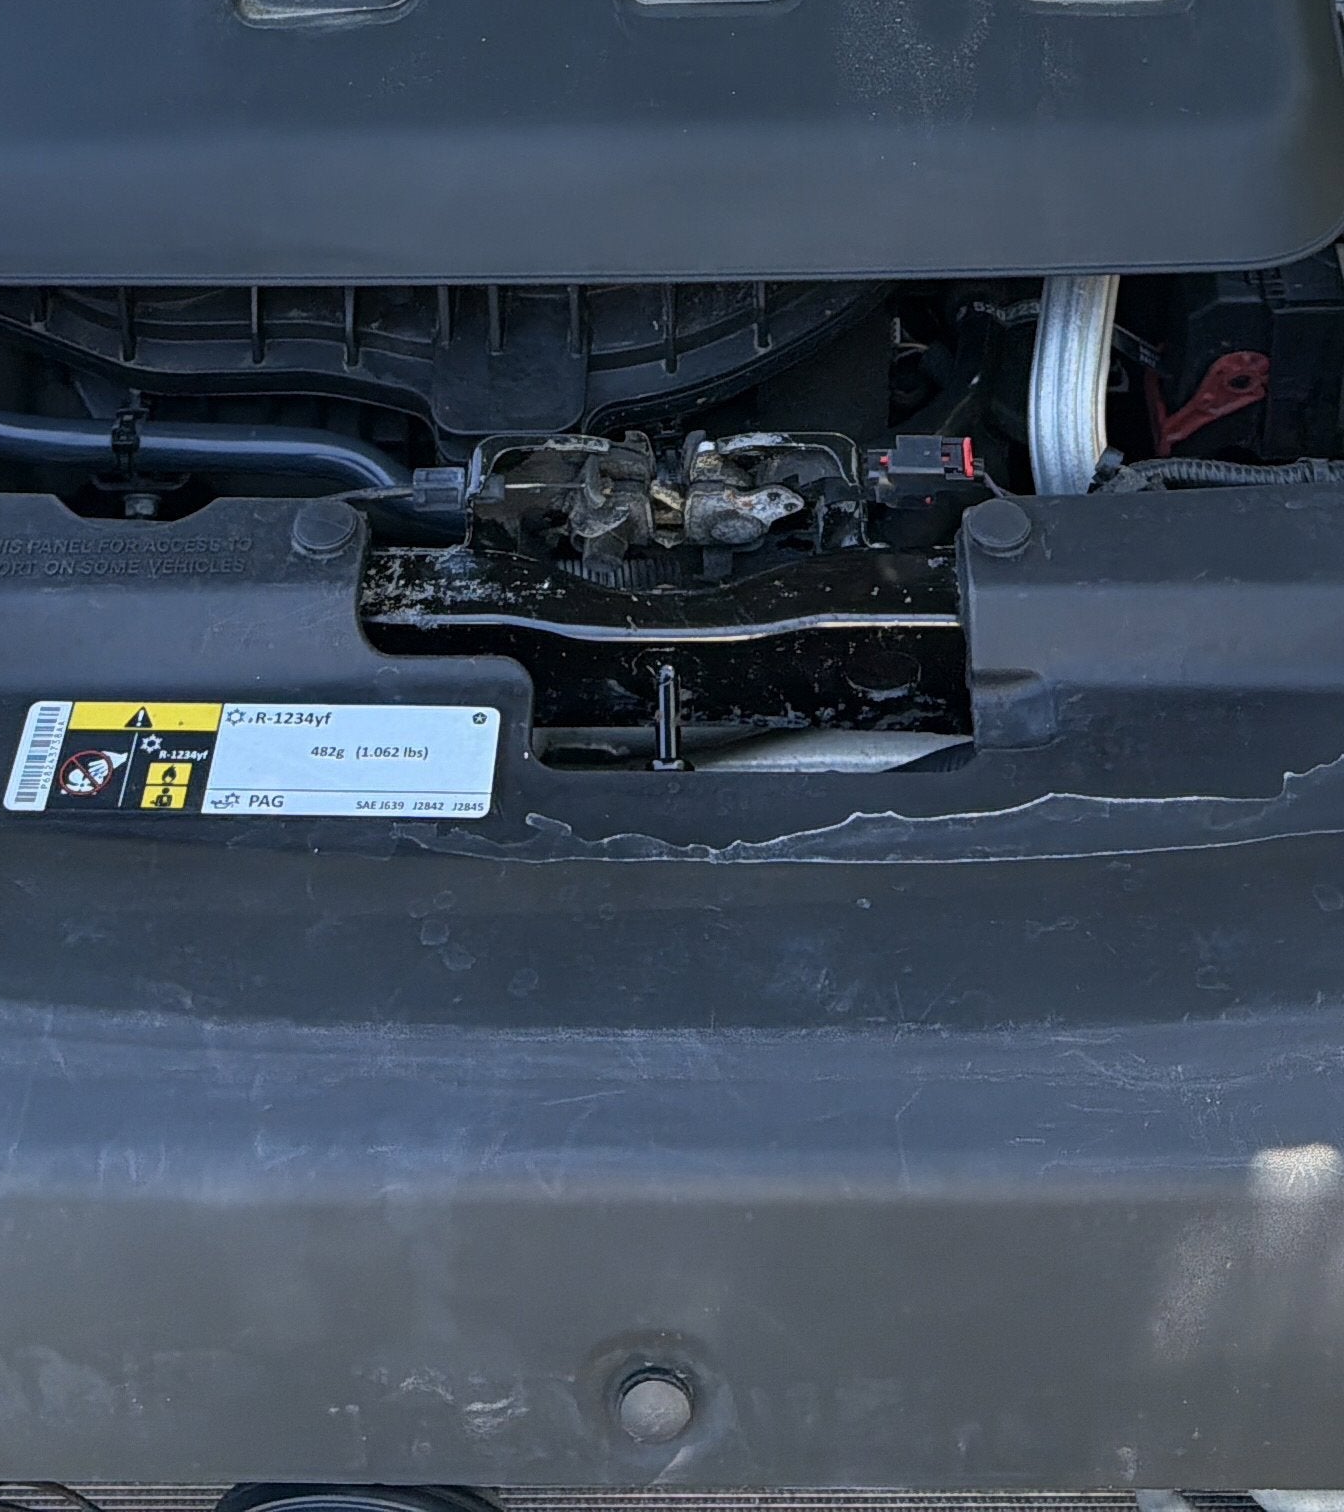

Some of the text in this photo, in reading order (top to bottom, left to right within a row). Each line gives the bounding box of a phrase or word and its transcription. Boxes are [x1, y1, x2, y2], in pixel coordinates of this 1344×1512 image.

[27, 538, 93, 554] PANEL
[96, 538, 141, 554] FOR
[142, 537, 223, 554] ACCESS
[225, 537, 254, 553] TO
[44, 559, 75, 576] ON
[79, 558, 142, 575] SOME
[147, 558, 246, 575] VEHICLES
[255, 711, 332, 727] R-1234yf
[158, 749, 209, 762] R-1234yf
[310, 746, 429, 761] 482g (1.062 lbs)
[248, 794, 284, 808] PAG
[355, 800, 485, 812] SAE J639 J2842 J2845
